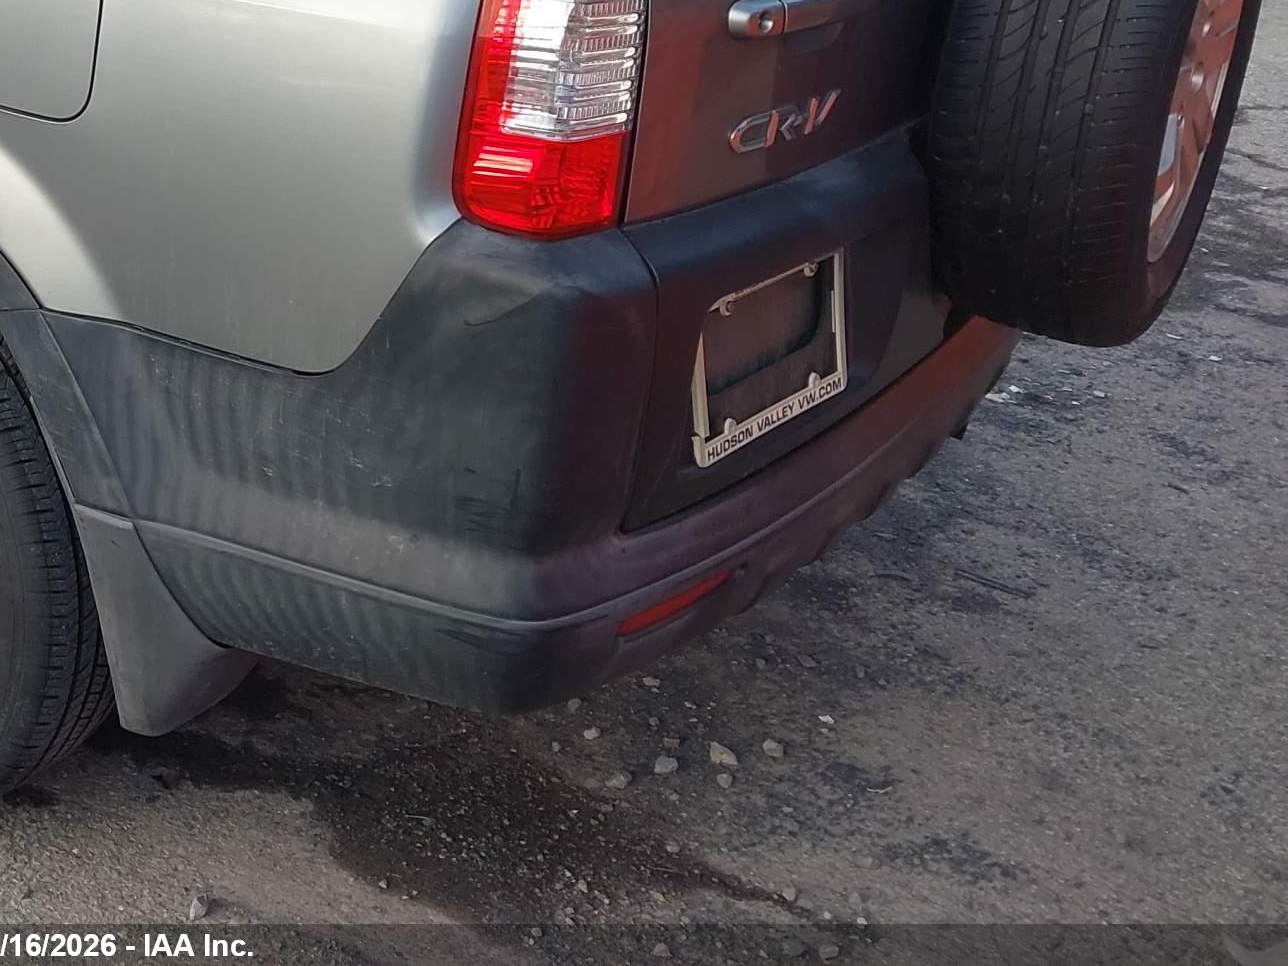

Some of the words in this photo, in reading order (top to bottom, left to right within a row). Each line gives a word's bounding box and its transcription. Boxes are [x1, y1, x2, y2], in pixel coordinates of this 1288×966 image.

[728, 89, 842, 154] CR-V
[707, 425, 754, 462] HUDSON
[756, 403, 797, 433] VALLEY
[798, 378, 842, 411] VW.COM
